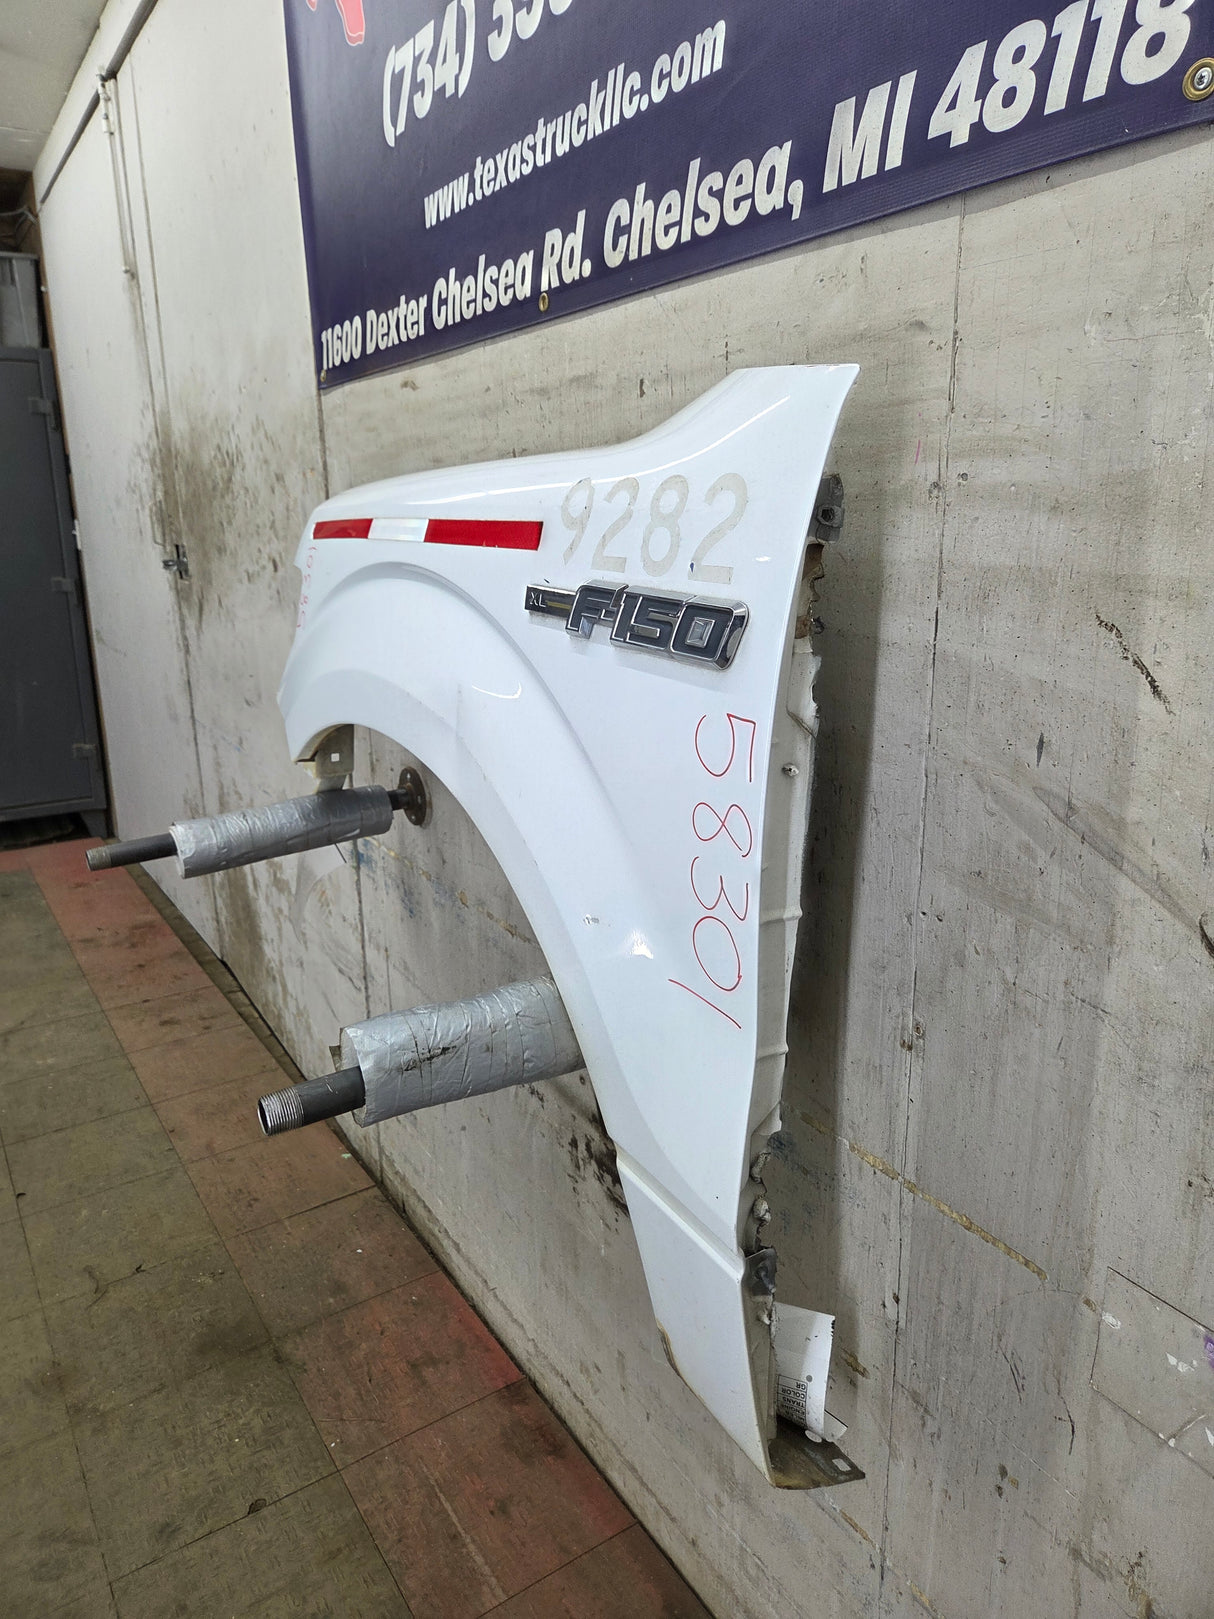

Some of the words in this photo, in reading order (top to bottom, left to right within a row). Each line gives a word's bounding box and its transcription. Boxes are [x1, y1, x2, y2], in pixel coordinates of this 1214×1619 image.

[382, 0, 475, 148] (734)
[423, 19, 726, 229] www.texastruckllc.com
[321, 314, 363, 370] 11600
[365, 293, 427, 355] Dexter
[431, 254, 534, 331] Chelsea
[540, 209, 592, 293] Rd.
[603, 140, 804, 269] Chelsea,
[822, 69, 918, 194] MI
[927, 0, 1197, 149] 48118
[560, 472, 749, 585] 9282
[529, 591, 547, 608] XL
[781, 1387, 806, 1400] COLOR
[782, 1396, 805, 1408] TRANS
